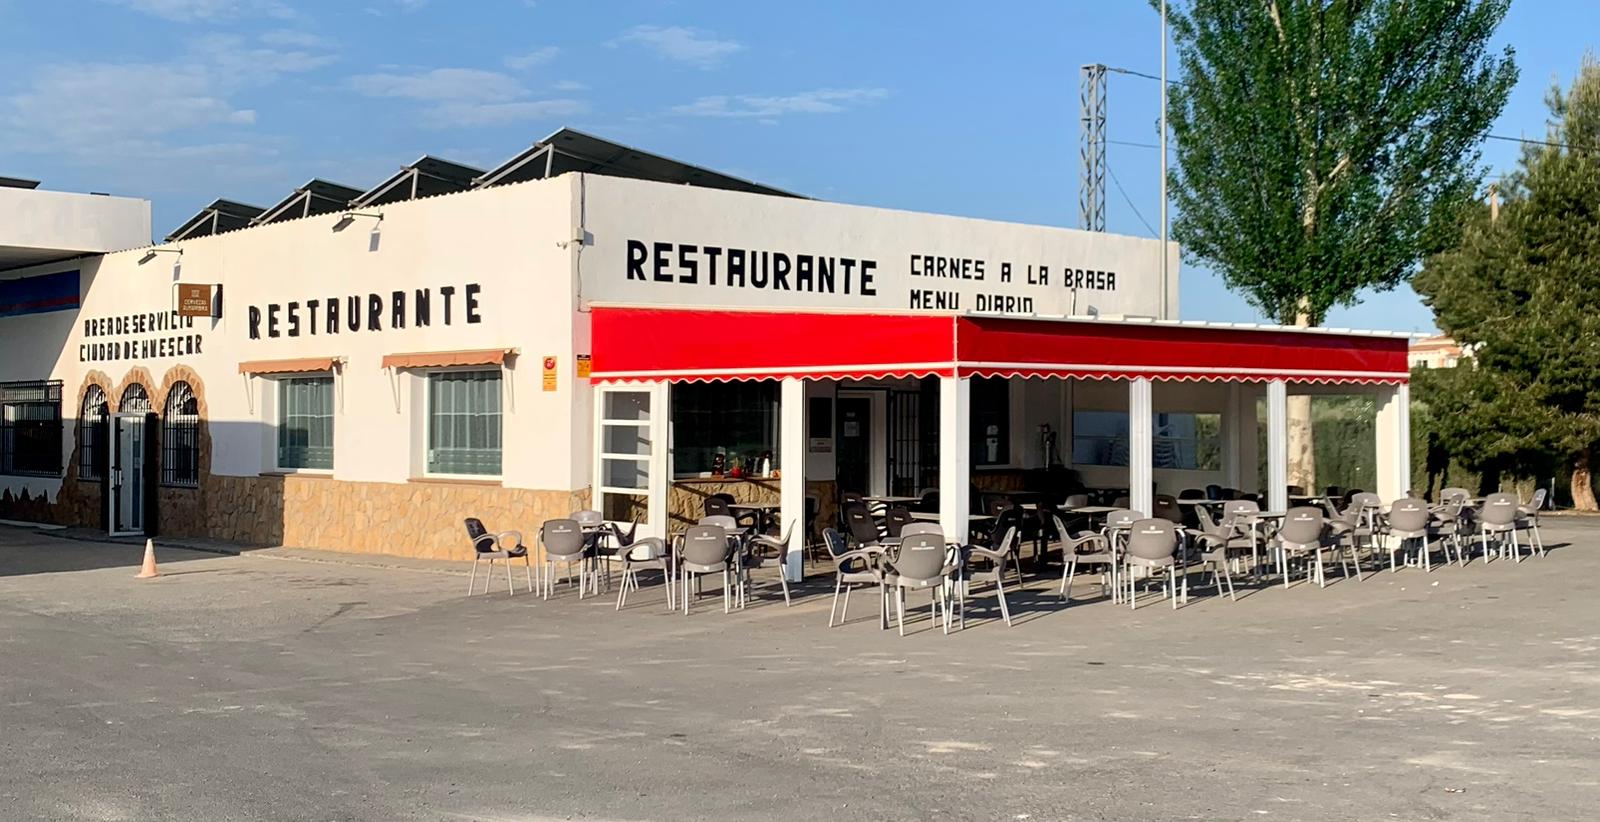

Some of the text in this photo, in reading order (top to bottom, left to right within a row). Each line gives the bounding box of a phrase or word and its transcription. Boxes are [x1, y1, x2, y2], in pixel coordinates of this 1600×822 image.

[627, 239, 877, 297] RESTAURANTE
[910, 255, 1116, 291] CARNES A LA BRASA
[248, 283, 482, 340] RESTAURANTE
[910, 289, 1034, 313] MENU DIARIO
[84, 311, 193, 338] AREA DE SERVICIO
[79, 335, 203, 362] CIUDAD DE HUESCAR
